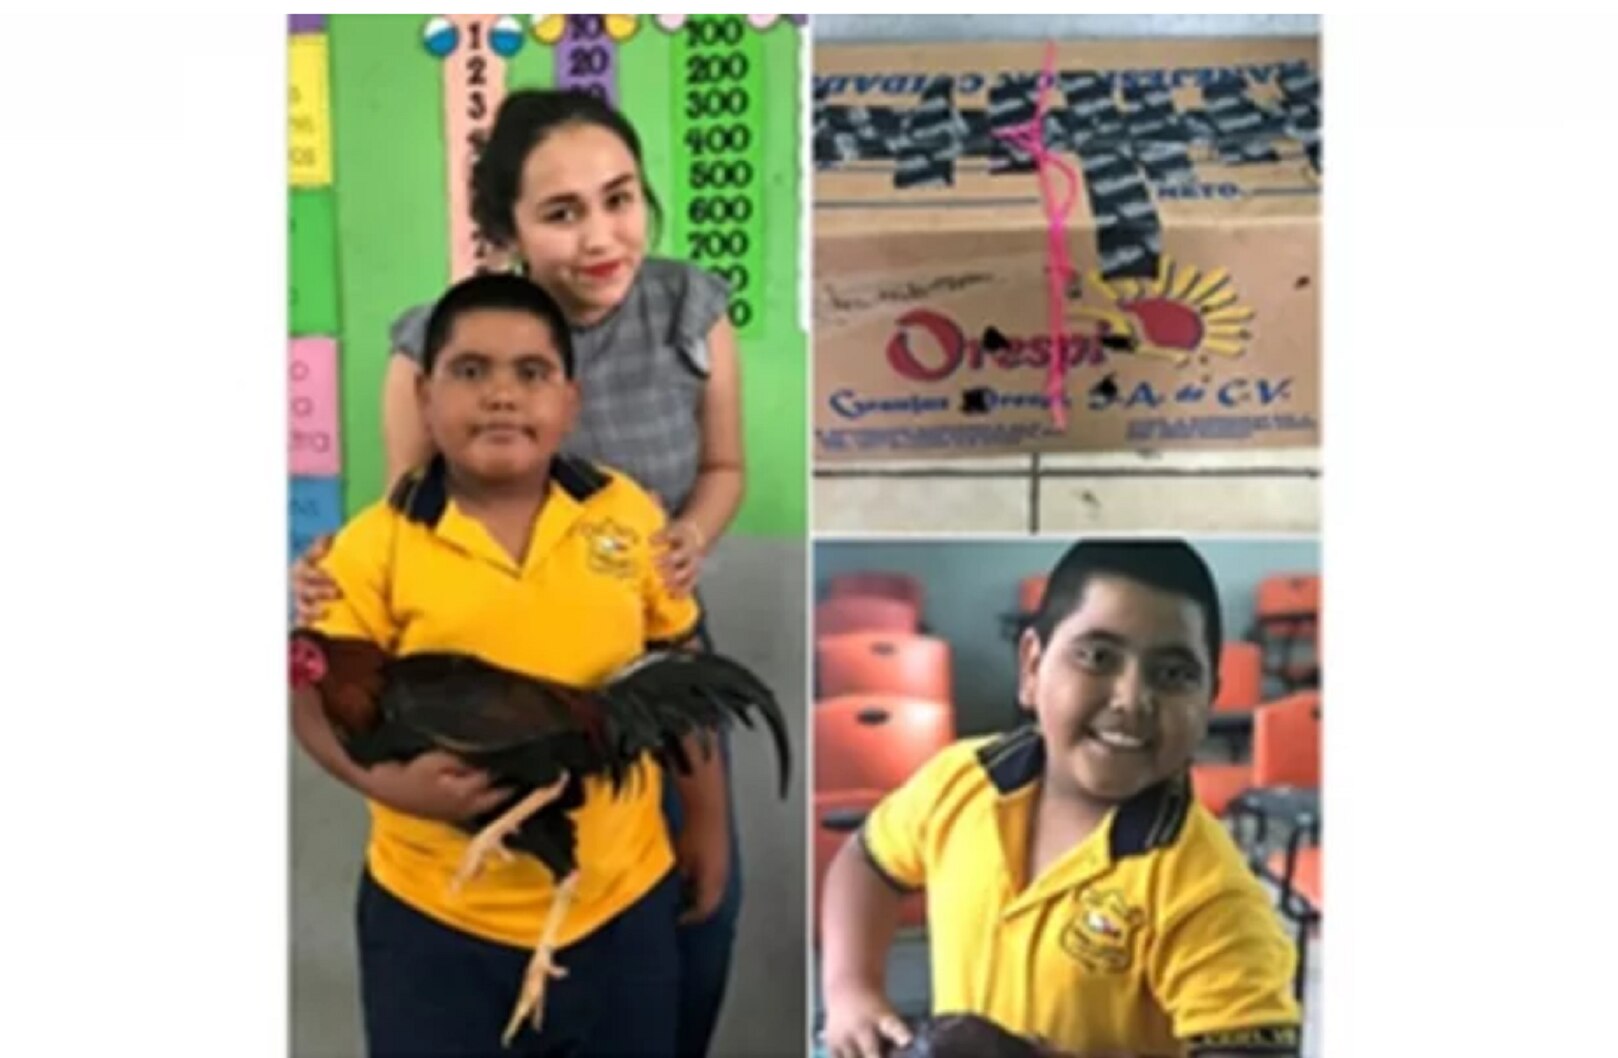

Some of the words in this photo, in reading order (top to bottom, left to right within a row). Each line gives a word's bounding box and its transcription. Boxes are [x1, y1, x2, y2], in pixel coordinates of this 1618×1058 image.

[467, 22, 482, 50] 1
[686, 16, 744, 47] 100
[466, 56, 487, 85] 2
[568, 46, 610, 77] 20
[685, 52, 749, 84] 200
[466, 90, 487, 119] 3
[685, 87, 750, 120] 300
[683, 122, 752, 156] 400
[689, 160, 753, 190] 500
[687, 194, 754, 225] 600
[686, 230, 749, 260] 700
